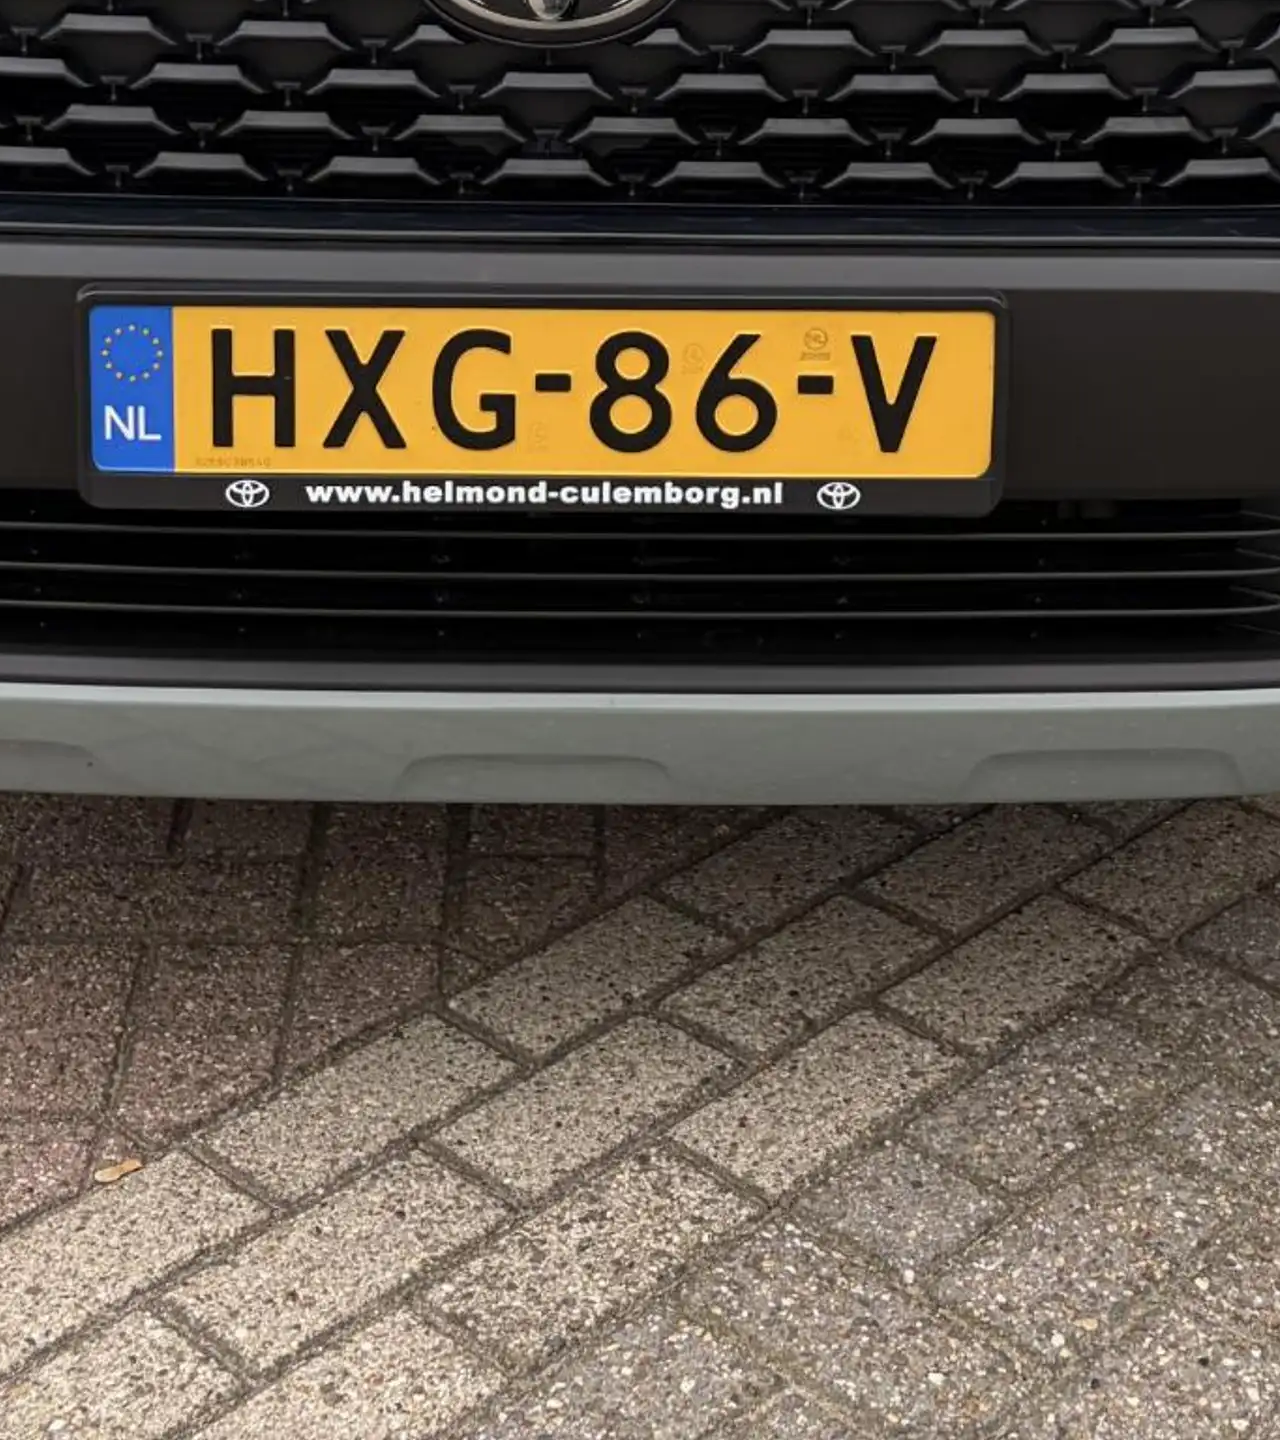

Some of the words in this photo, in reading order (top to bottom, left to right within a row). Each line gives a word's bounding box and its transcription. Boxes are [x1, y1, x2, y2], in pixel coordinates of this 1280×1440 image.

[103, 404, 163, 442] NL
[210, 326, 939, 454] HXG-86-V
[304, 479, 785, 510] www.helmond-culemborg.nl
